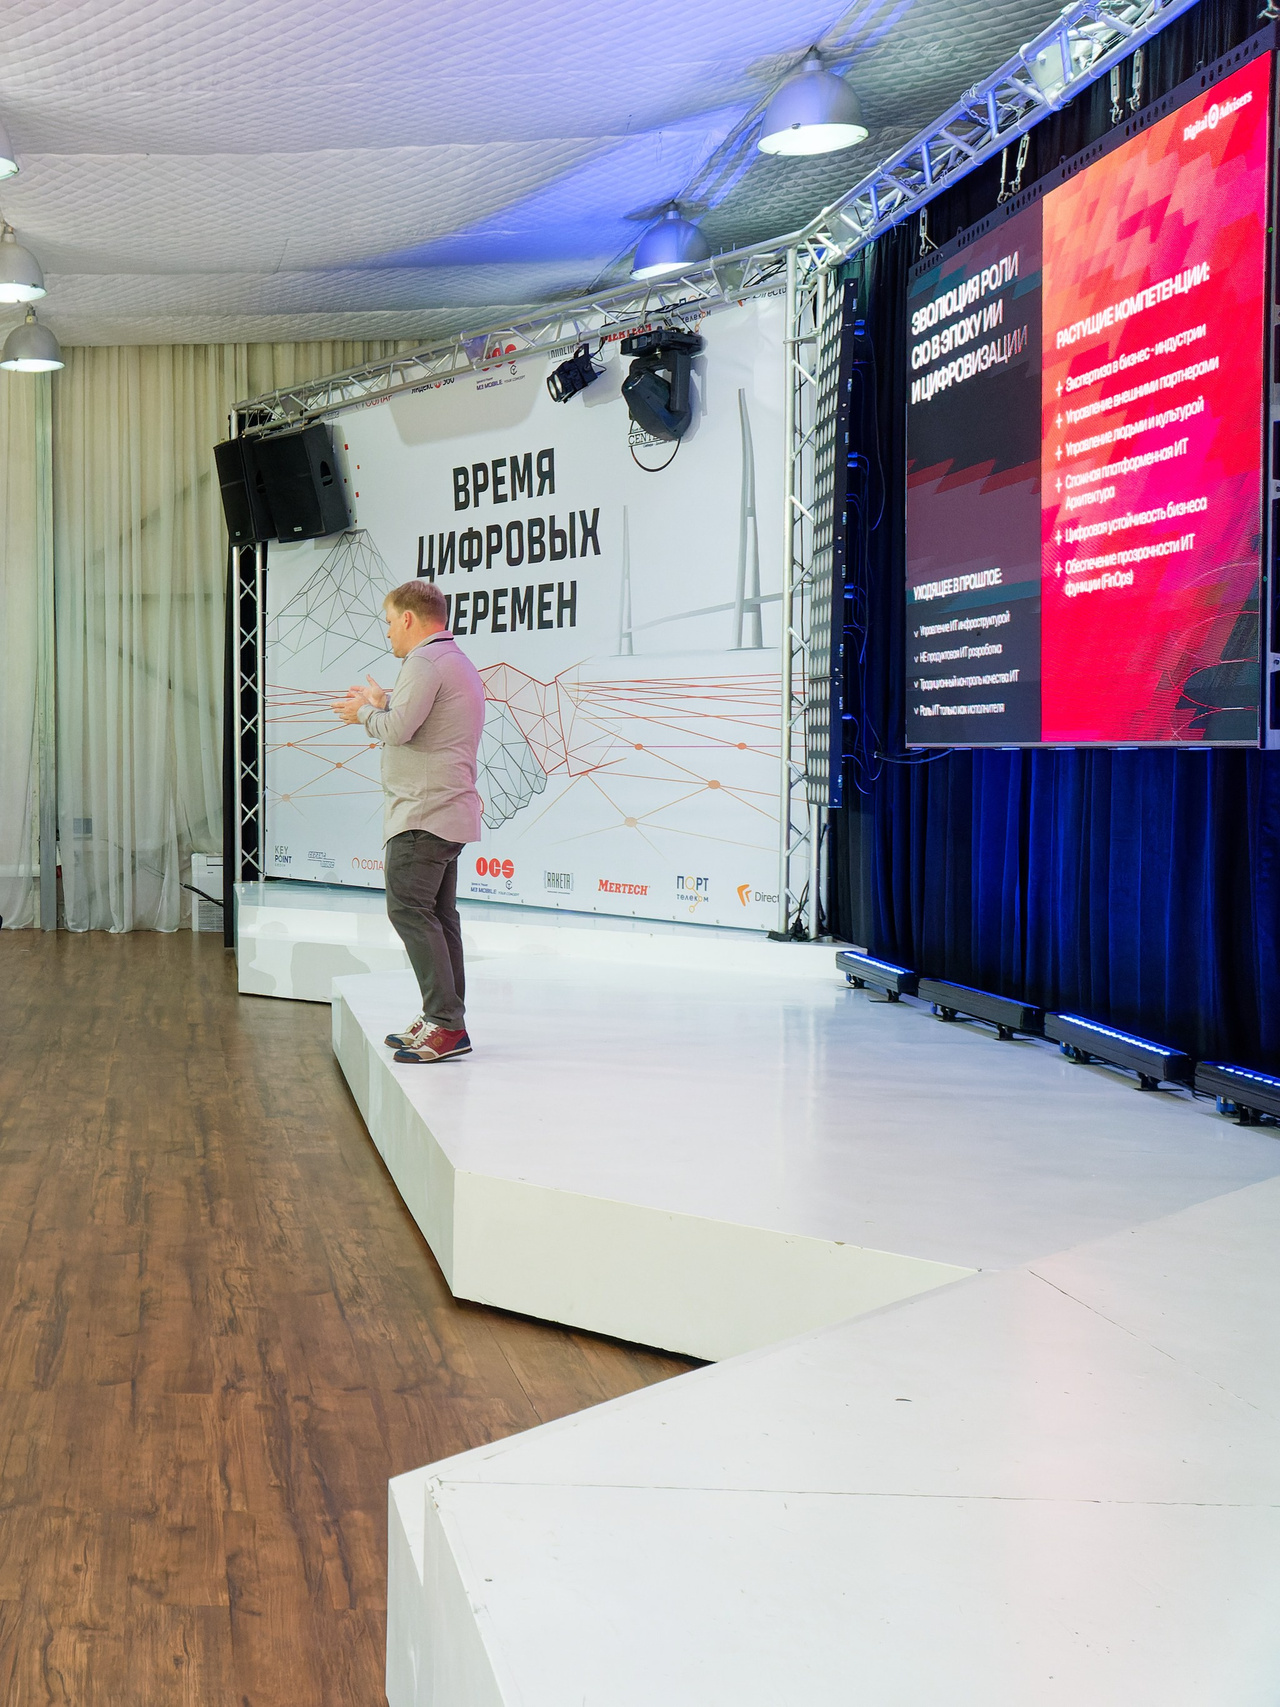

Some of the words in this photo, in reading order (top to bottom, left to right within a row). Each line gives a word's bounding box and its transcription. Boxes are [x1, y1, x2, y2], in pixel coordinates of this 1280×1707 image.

[1183, 115, 1208, 141] Digital
[911, 274, 980, 336] ЭВОЛЮЦИЯ
[981, 251, 1019, 296] РОЛИ
[1056, 306, 1114, 349] РАСТУЩИЕ
[1114, 261, 1210, 322] КОМПЕТЕНЦИИ:
[931, 334, 940, 360] В
[940, 310, 983, 354] ЭПОХУ
[983, 299, 1004, 333] ИИ
[911, 379, 921, 405] И
[921, 324, 1028, 402] ЦИФРОВИЗАЦИИ
[1065, 363, 1112, 392] Экспертиза
[1112, 360, 1119, 373] в
[1065, 397, 1113, 424] Управление
[1113, 378, 1159, 407] внешними
[1159, 356, 1219, 388] партнерами
[1065, 430, 1112, 457] Управление
[1112, 420, 1148, 441] людьми
[1148, 418, 1155, 430] и
[1155, 395, 1204, 428] культурой
[452, 447, 556, 511] ВРЕМЯ
[1065, 467, 1102, 489] Сложная
[1101, 445, 1174, 478] платформенная
[1174, 437, 1189, 457] ИТ
[1065, 485, 1116, 511] Архитектура
[1065, 523, 1108, 545] Цифровая
[1107, 507, 1167, 536] устойчивость
[1166, 497, 1208, 518] бизнеса
[416, 507, 601, 583] ЦИФРОВЫХ
[1065, 552, 1117, 574] Обеспечение
[1117, 539, 1180, 566] прозрачности
[1180, 533, 1195, 551] ИТ
[913, 579, 953, 601] УХОДЯЩЕЕ
[953, 577, 960, 593] В
[959, 568, 1003, 592] ПРОШЛОЕ:
[1064, 579, 1101, 597] функции
[1101, 569, 1134, 590] (FinOps)
[274, 845, 289, 855] KEY
[274, 855, 292, 864] POINT
[361, 859, 384, 871] СОЛА
[476, 857, 514, 879] OCS
[676, 875, 709, 892] ПОРТ
[676, 893, 709, 903] телеком
